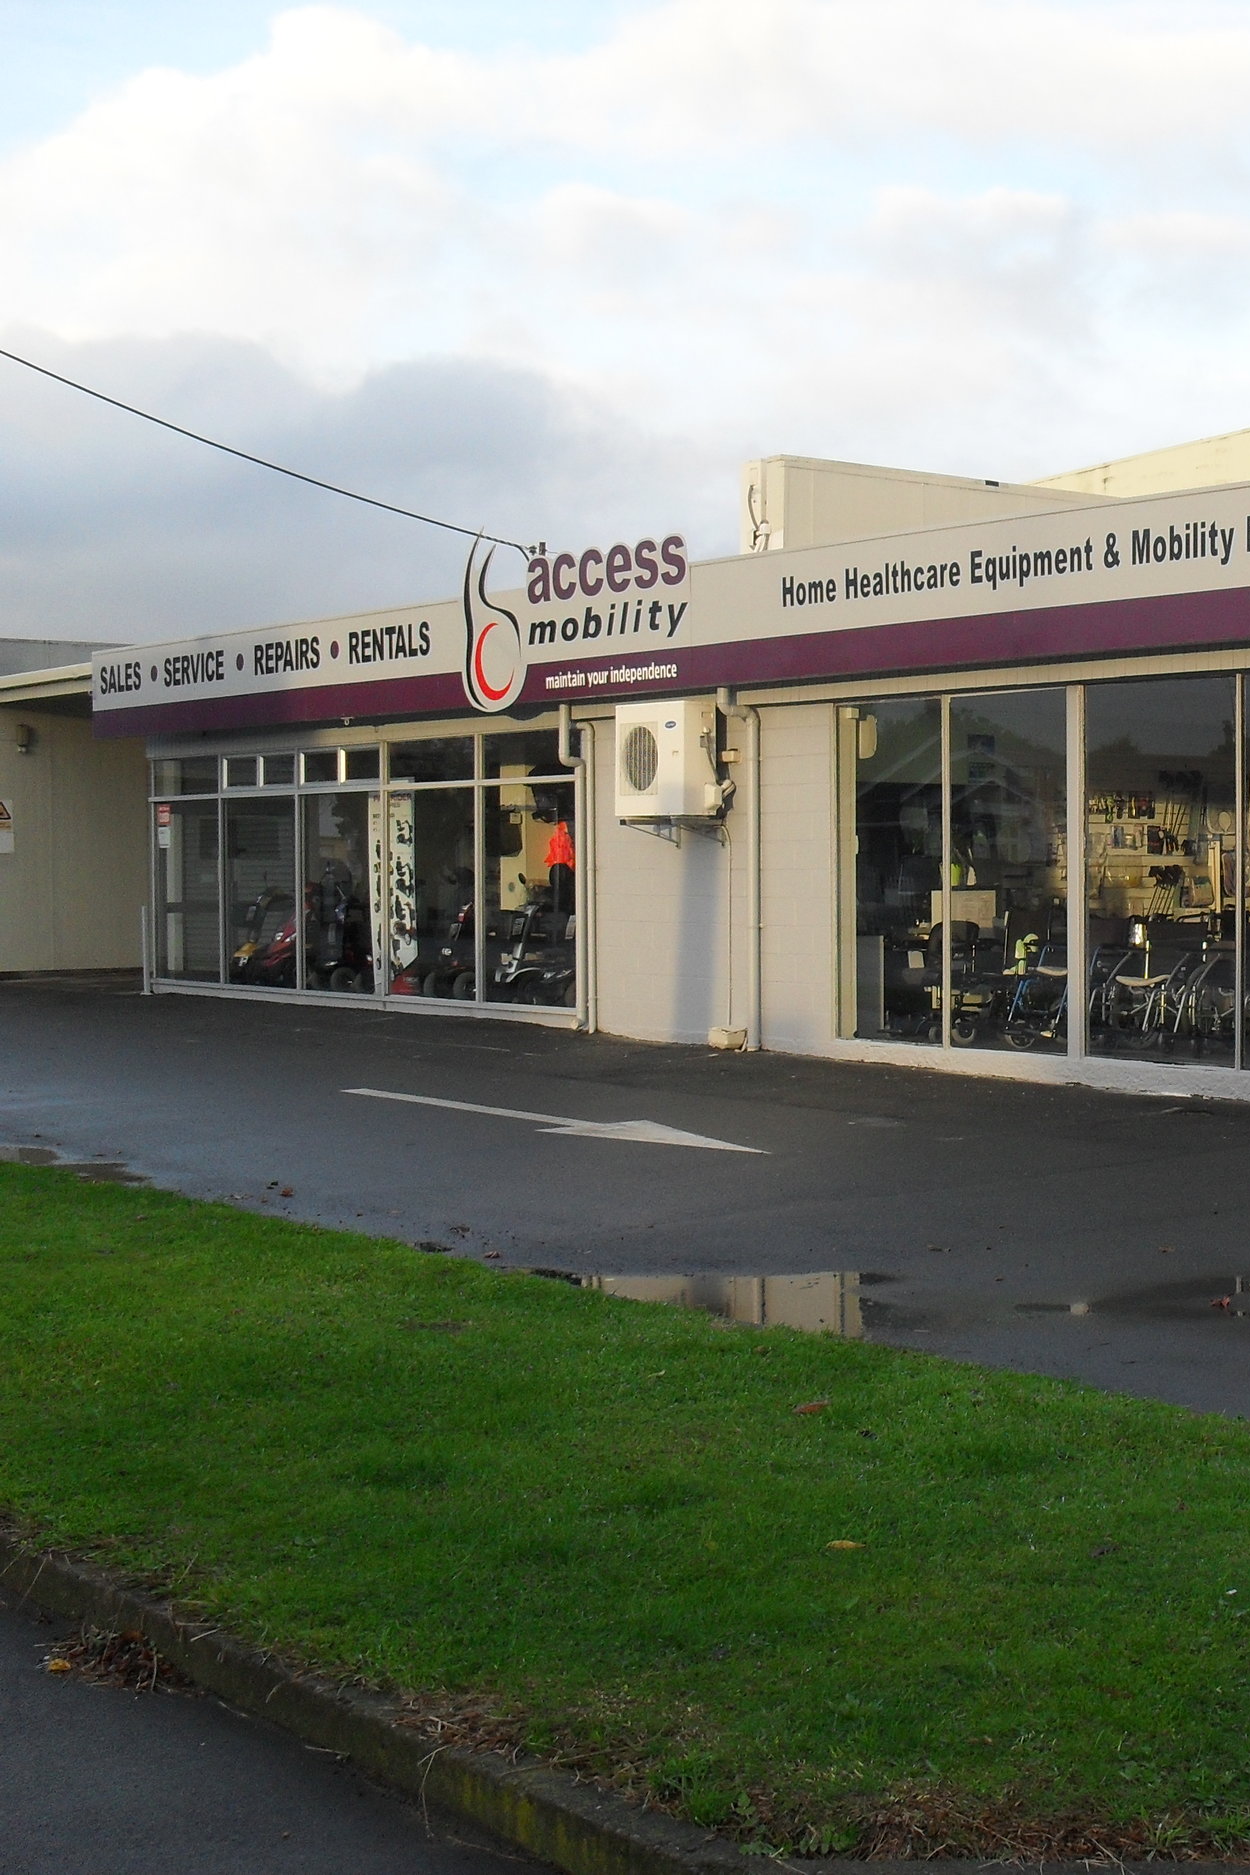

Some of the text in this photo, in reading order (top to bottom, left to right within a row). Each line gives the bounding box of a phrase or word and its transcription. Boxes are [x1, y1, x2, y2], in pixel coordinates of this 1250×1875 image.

[527, 535, 687, 605] access
[781, 575, 837, 608] Home
[844, 560, 961, 600] Healthcare
[970, 536, 1093, 591] Equipment
[1103, 532, 1121, 569] &
[1131, 520, 1235, 566] Mobility
[528, 599, 689, 646] mobility
[100, 621, 431, 695] SALES SERVICE REPAIRS RENTALS
[545, 662, 678, 690] maintain your independence
